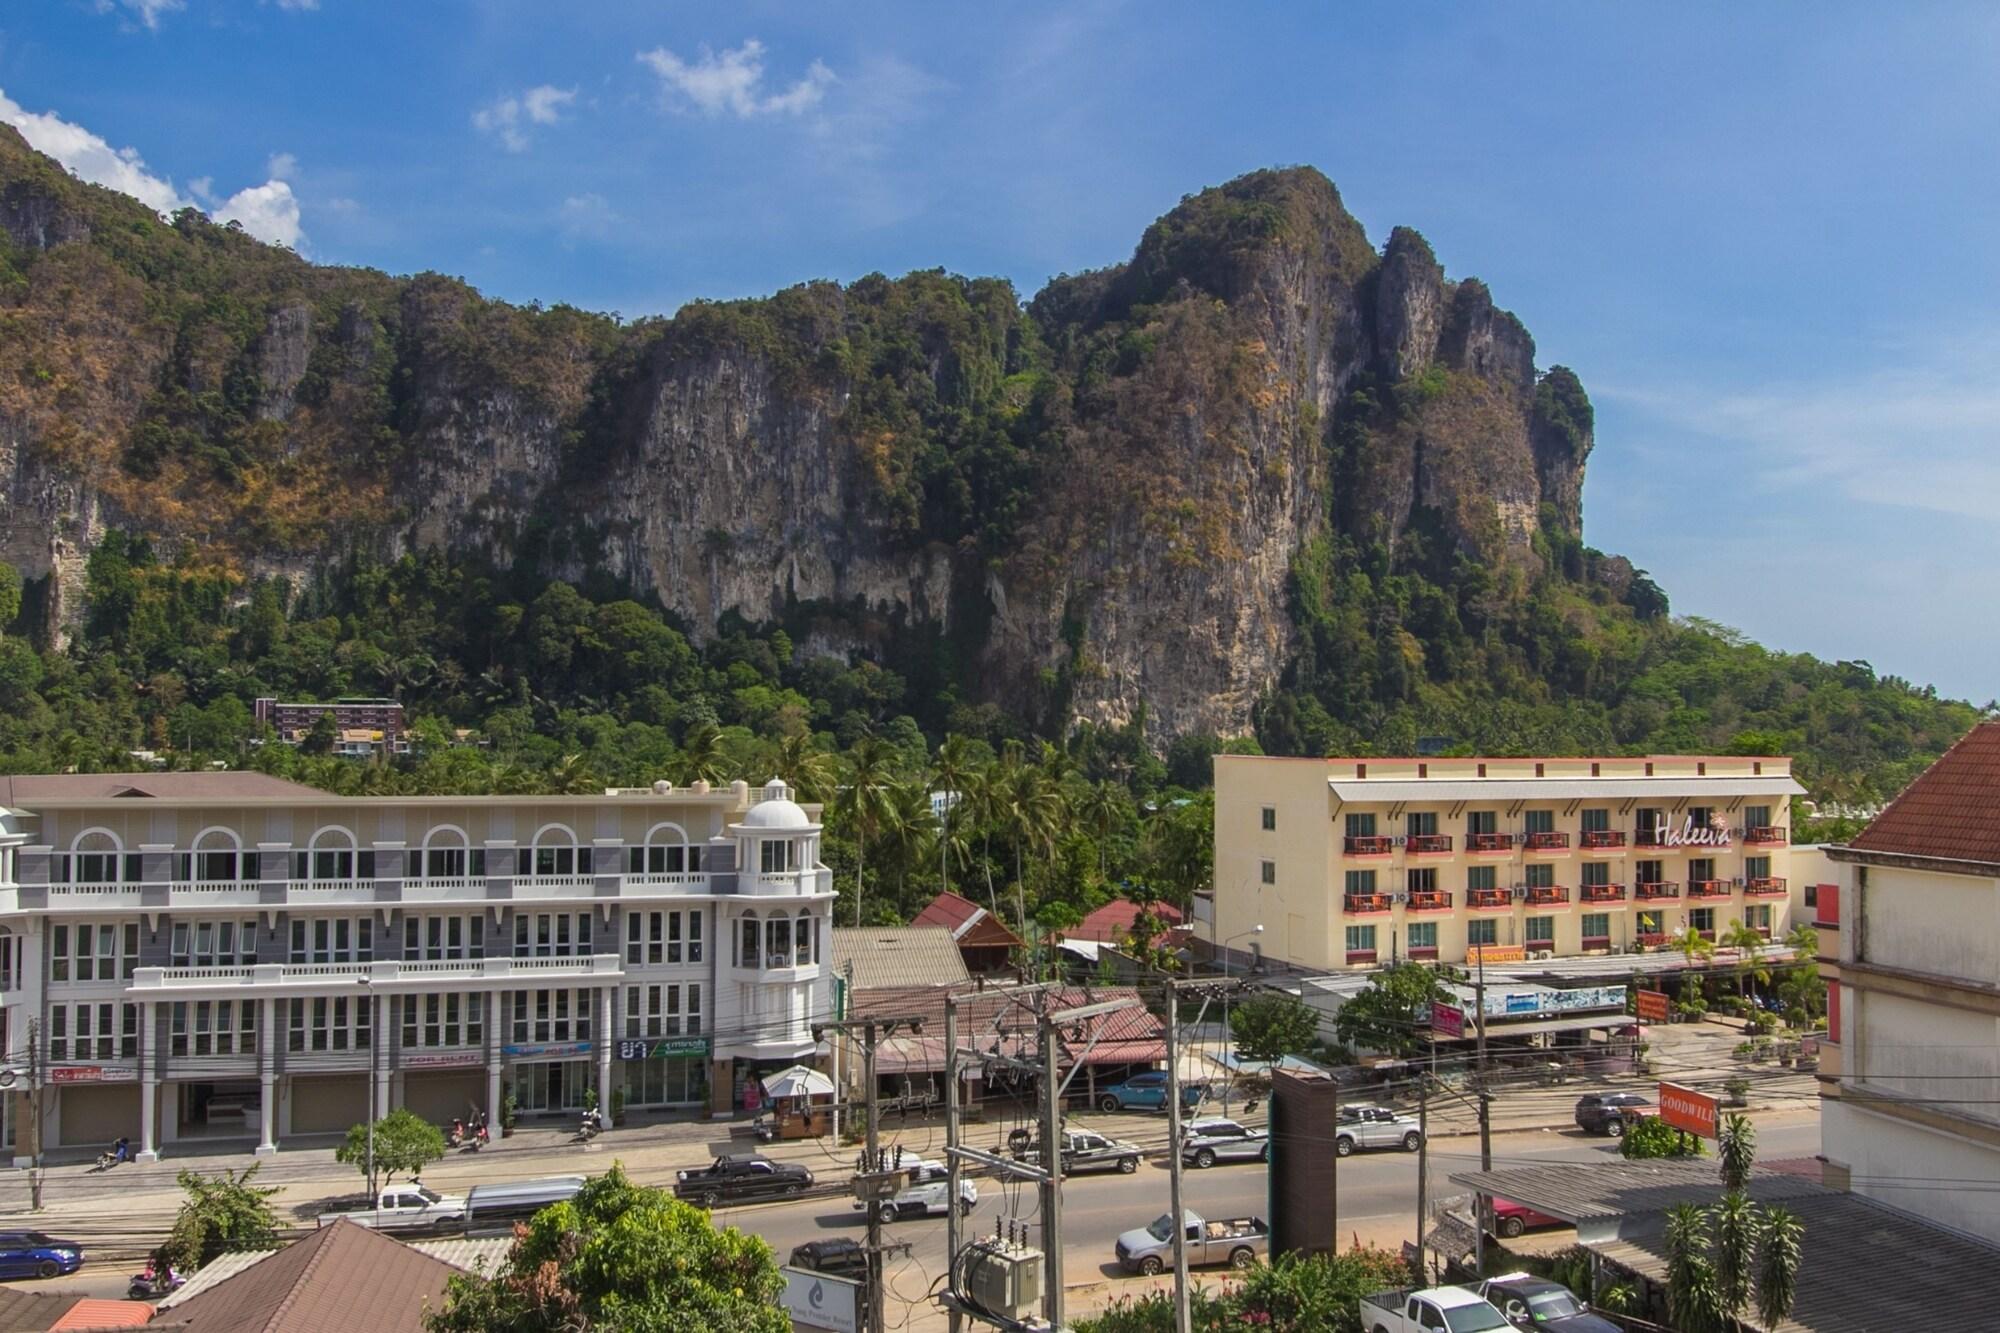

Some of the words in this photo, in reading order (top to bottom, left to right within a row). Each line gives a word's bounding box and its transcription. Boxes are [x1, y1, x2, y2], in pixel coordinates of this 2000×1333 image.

[1655, 812, 1731, 847] Haleeva
[621, 1041, 647, 1059] ยา
[1661, 1094, 1713, 1122] GOODWILL
